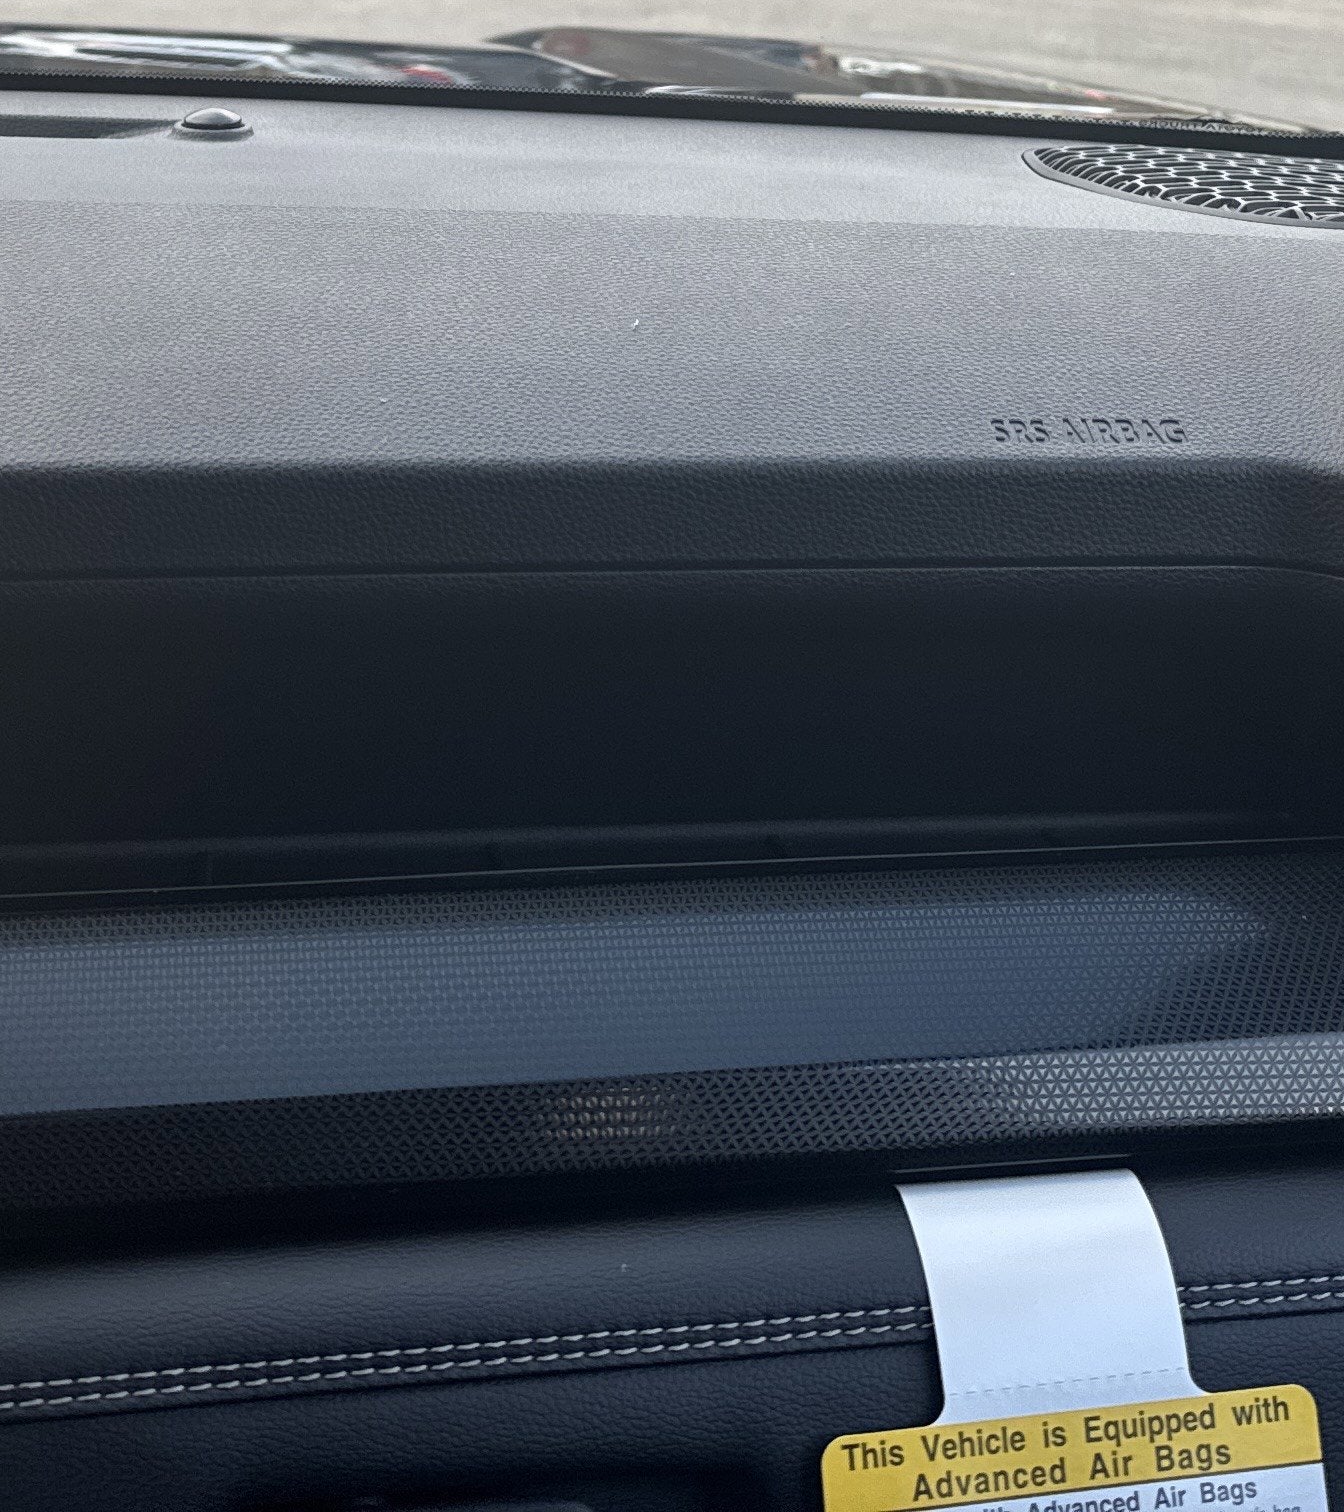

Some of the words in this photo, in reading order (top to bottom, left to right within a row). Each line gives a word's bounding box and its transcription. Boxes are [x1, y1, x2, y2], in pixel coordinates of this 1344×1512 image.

[990, 418, 1050, 443] SRS
[1061, 418, 1188, 444] AIRBAG
[841, 1442, 904, 1471] This
[921, 1427, 1026, 1461] Vehicle
[1043, 1426, 1067, 1449] is
[1084, 1404, 1216, 1444] Equipped
[1231, 1396, 1290, 1425] with
[913, 1463, 1066, 1501] Advanced
[1090, 1451, 1132, 1480] Air
[1155, 1439, 1231, 1472] Bags
[1154, 1480, 1187, 1510] Air
[1200, 1479, 1258, 1503] Bags
